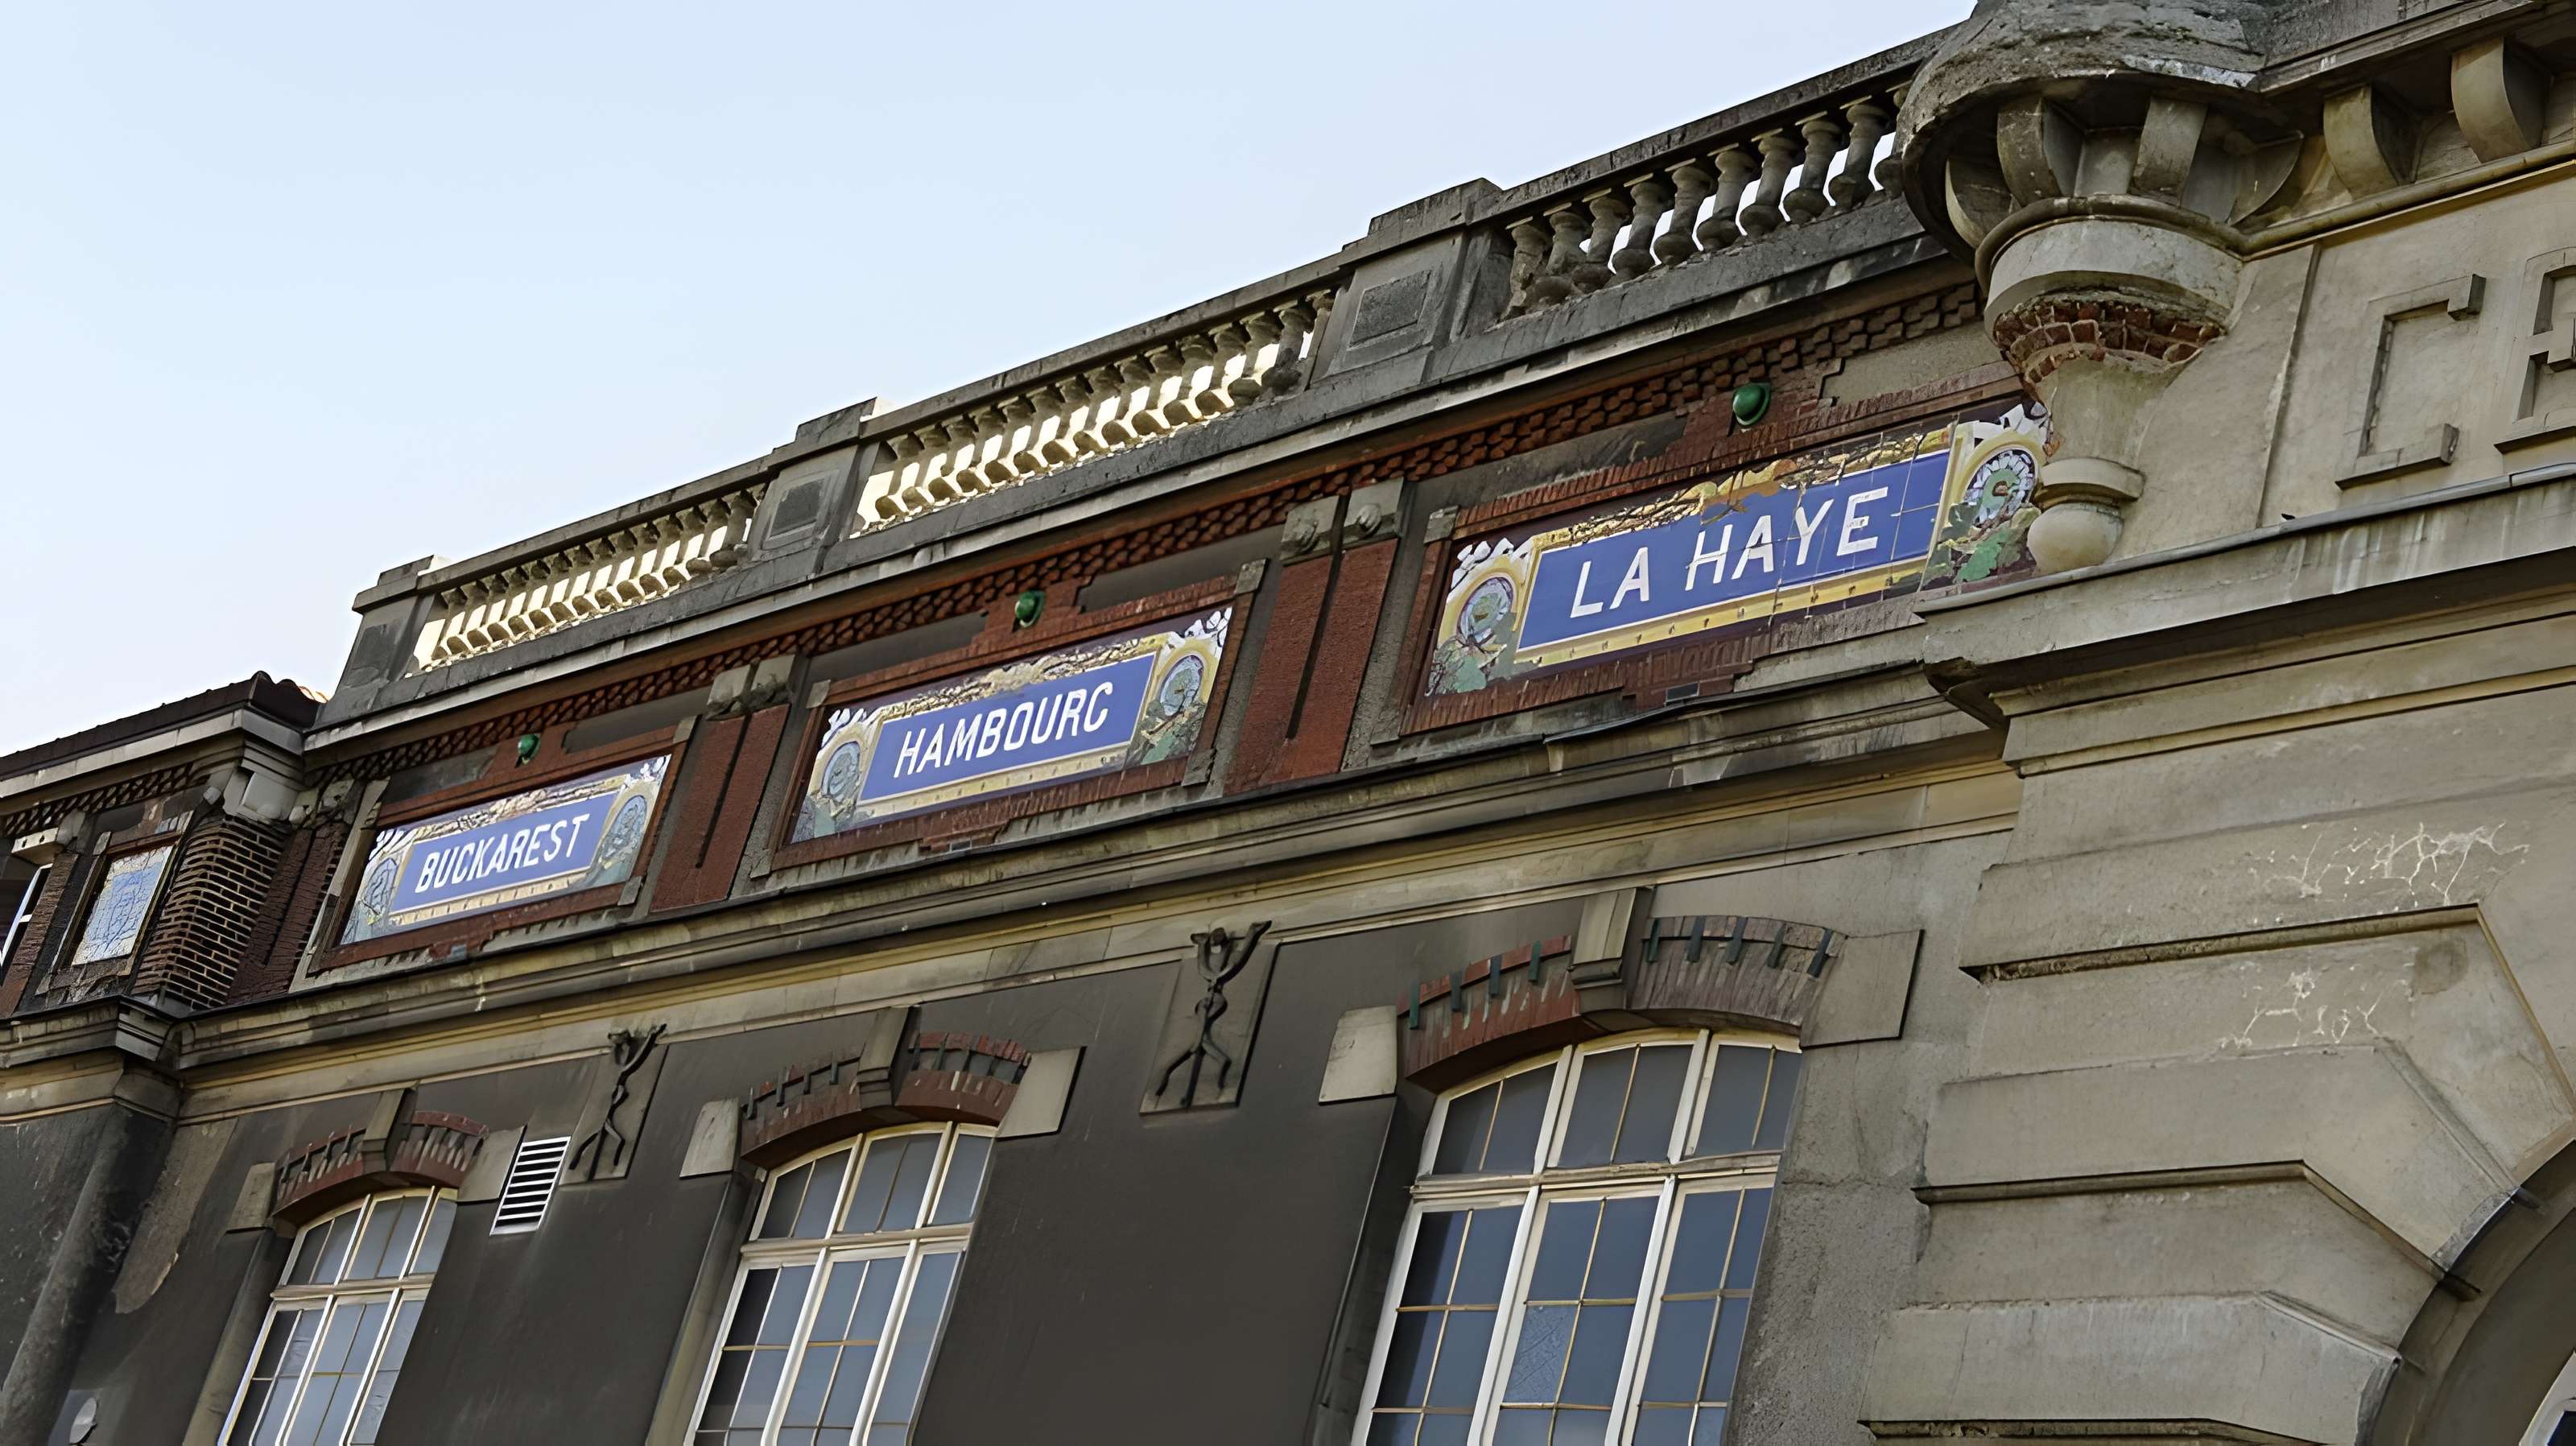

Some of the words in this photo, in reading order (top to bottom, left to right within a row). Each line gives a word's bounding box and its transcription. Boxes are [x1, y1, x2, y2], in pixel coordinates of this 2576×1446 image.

[1569, 546, 1650, 619] LA
[1684, 486, 1889, 591] HAYE
[414, 812, 590, 894] BUCKAREST
